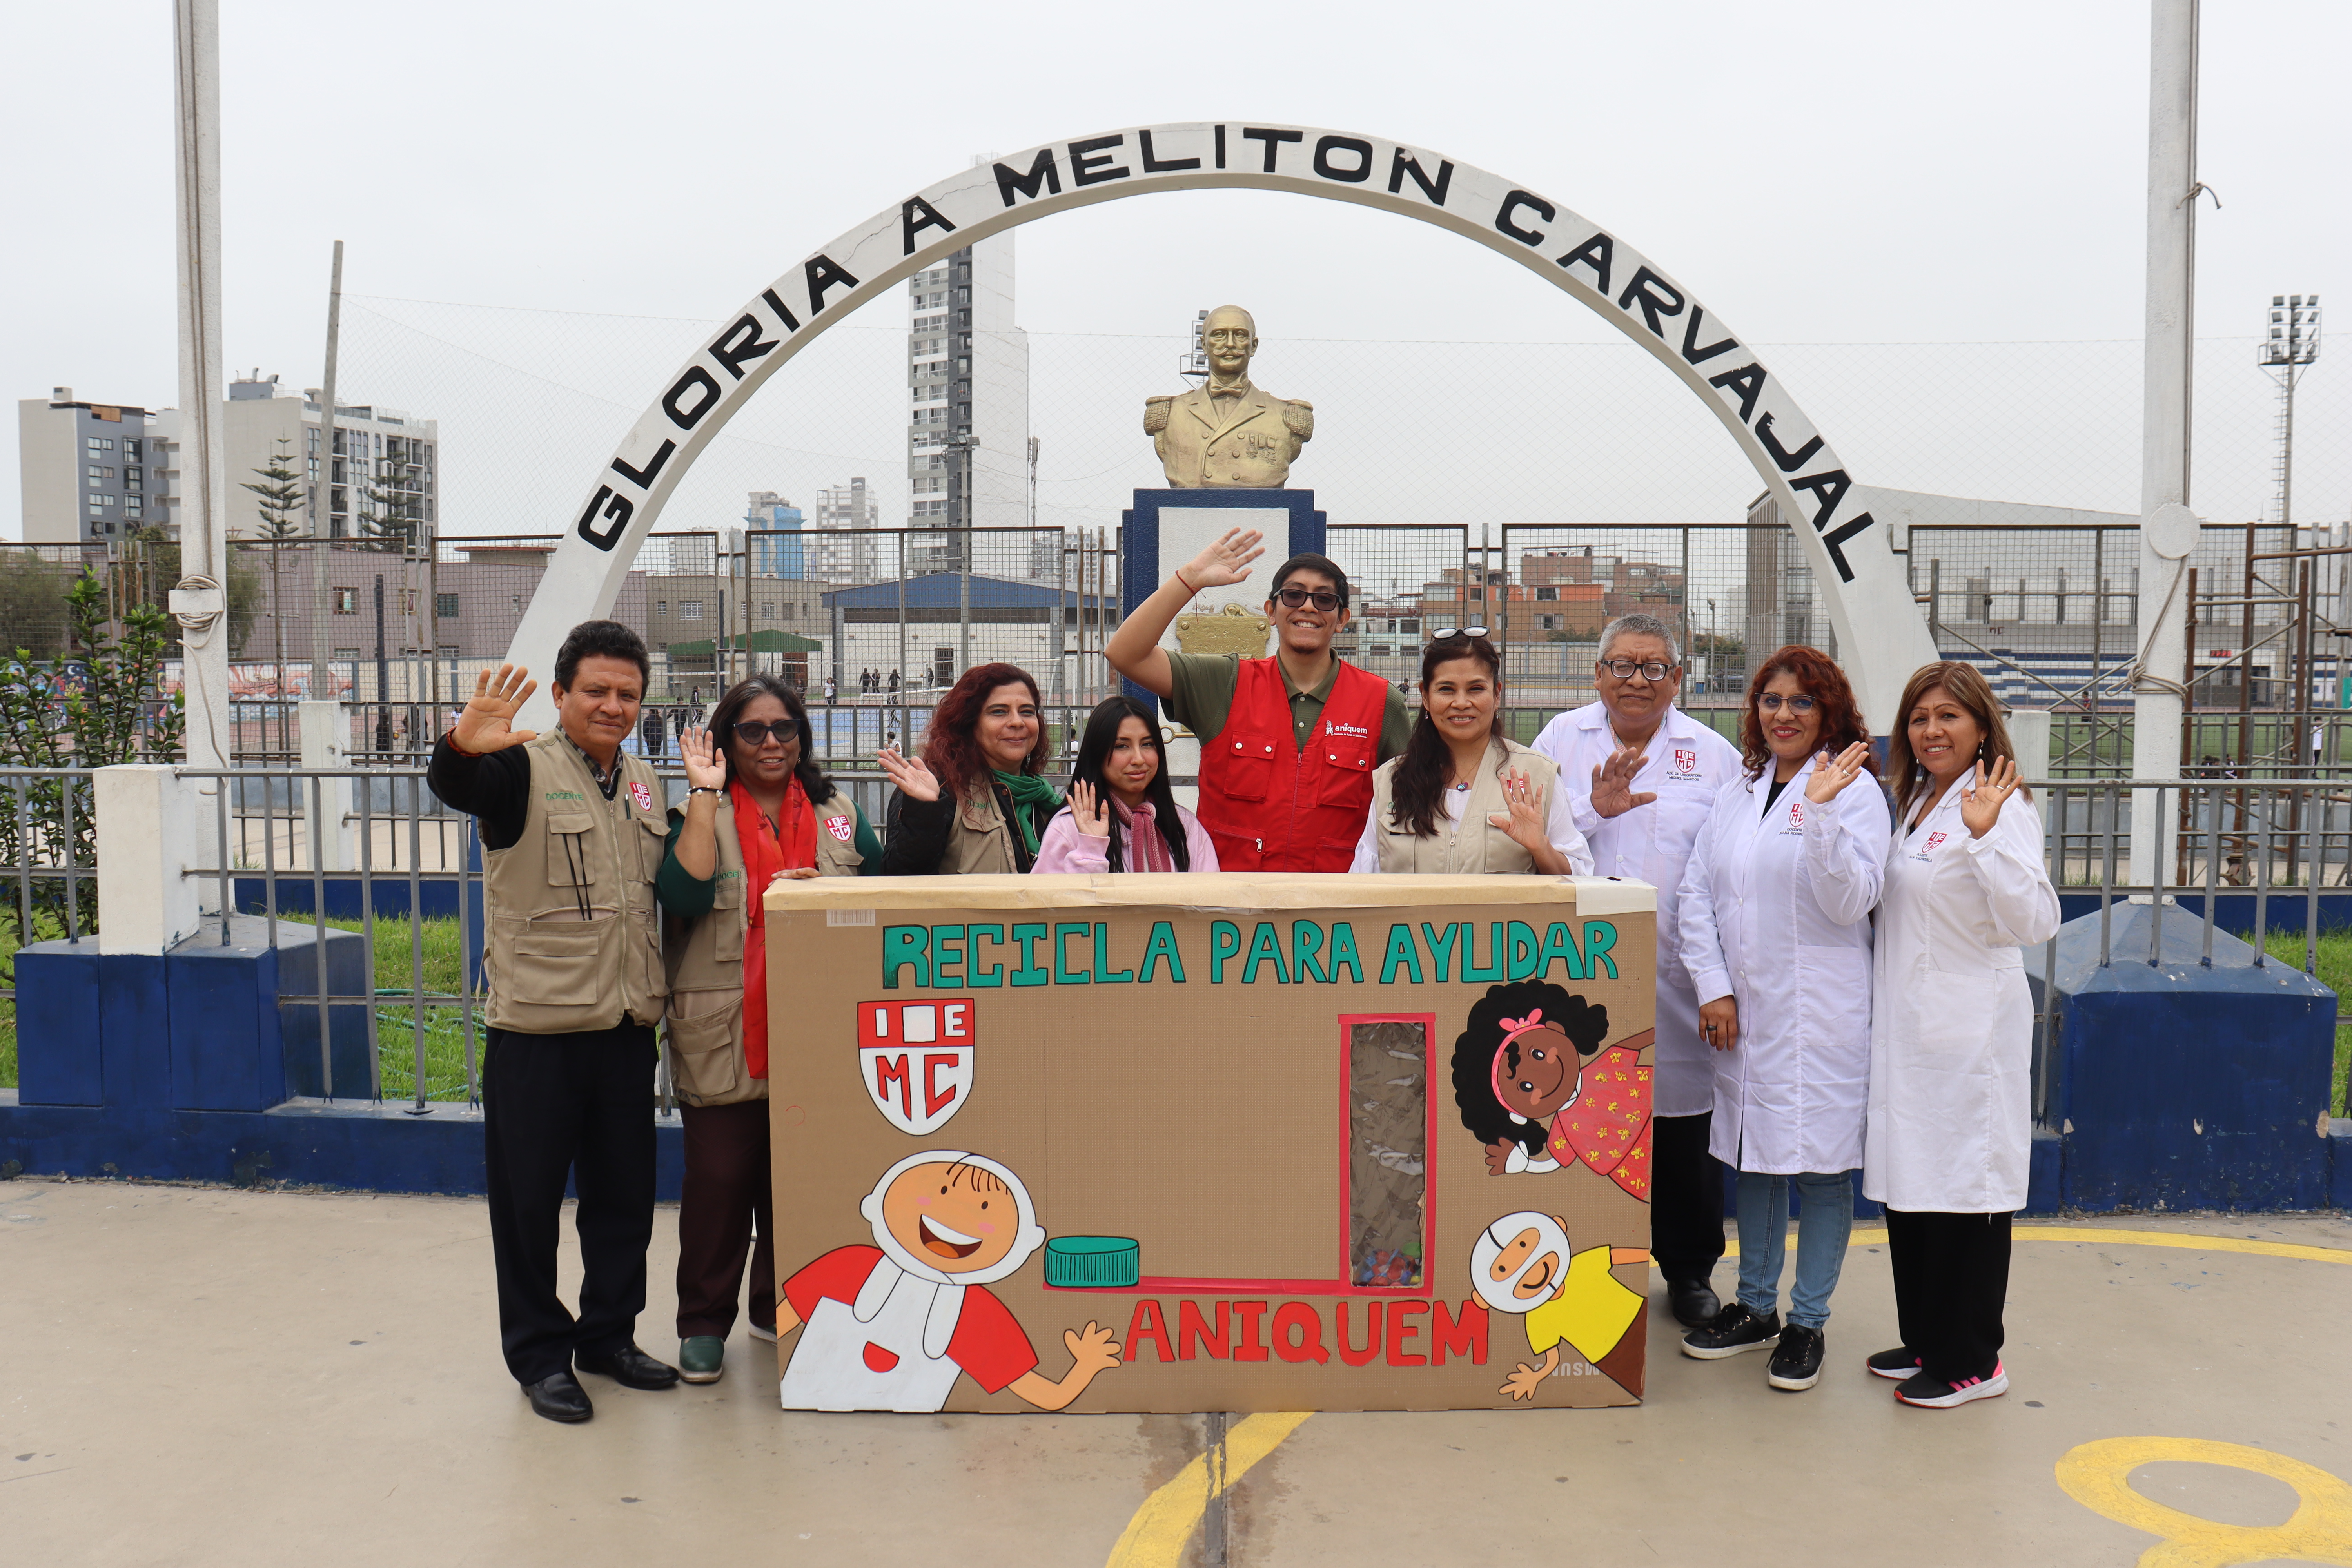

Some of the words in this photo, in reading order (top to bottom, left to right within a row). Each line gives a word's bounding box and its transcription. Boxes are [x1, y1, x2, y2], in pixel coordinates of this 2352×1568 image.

[578, 255, 859, 551] GLORIA
[903, 196, 956, 256] A
[993, 124, 1454, 207] MELITON
[1495, 190, 1874, 583] CARVAJAL
[1335, 723, 1367, 734] aniquem
[546, 792, 584, 800] DOCENTE
[718, 870, 739, 880] DOCE
[882, 921, 1186, 989] RECICLA
[1210, 919, 1364, 984] PARA
[1379, 920, 1619, 984] AYUDAR
[1123, 1299, 1489, 1367] ANIQUEM
